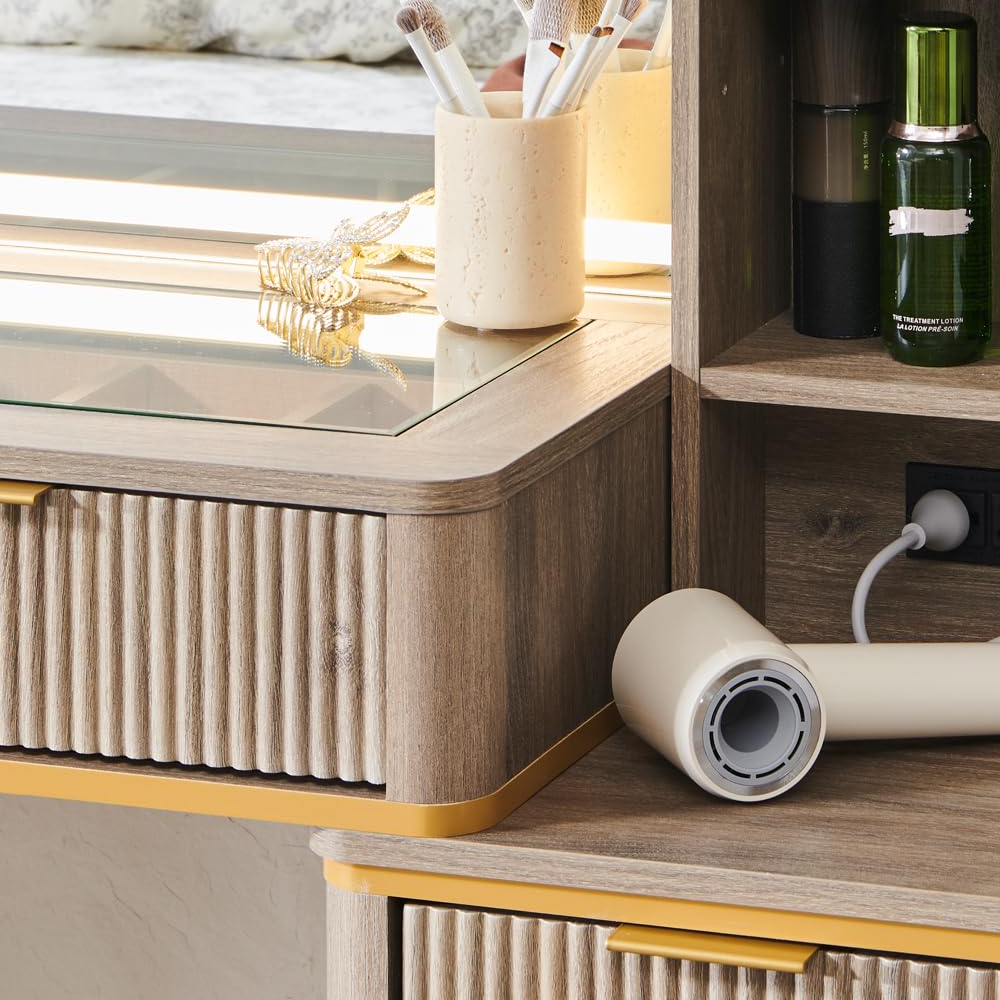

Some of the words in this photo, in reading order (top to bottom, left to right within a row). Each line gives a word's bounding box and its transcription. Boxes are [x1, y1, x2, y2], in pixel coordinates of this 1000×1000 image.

[892, 313, 903, 322] THE
[902, 316, 939, 324] TREATMENT
[940, 317, 964, 325] LOTION
[896, 322, 904, 330] LA
[904, 324, 928, 332] LOTION
[927, 325, 959, 333] PRÉ-SOIN
